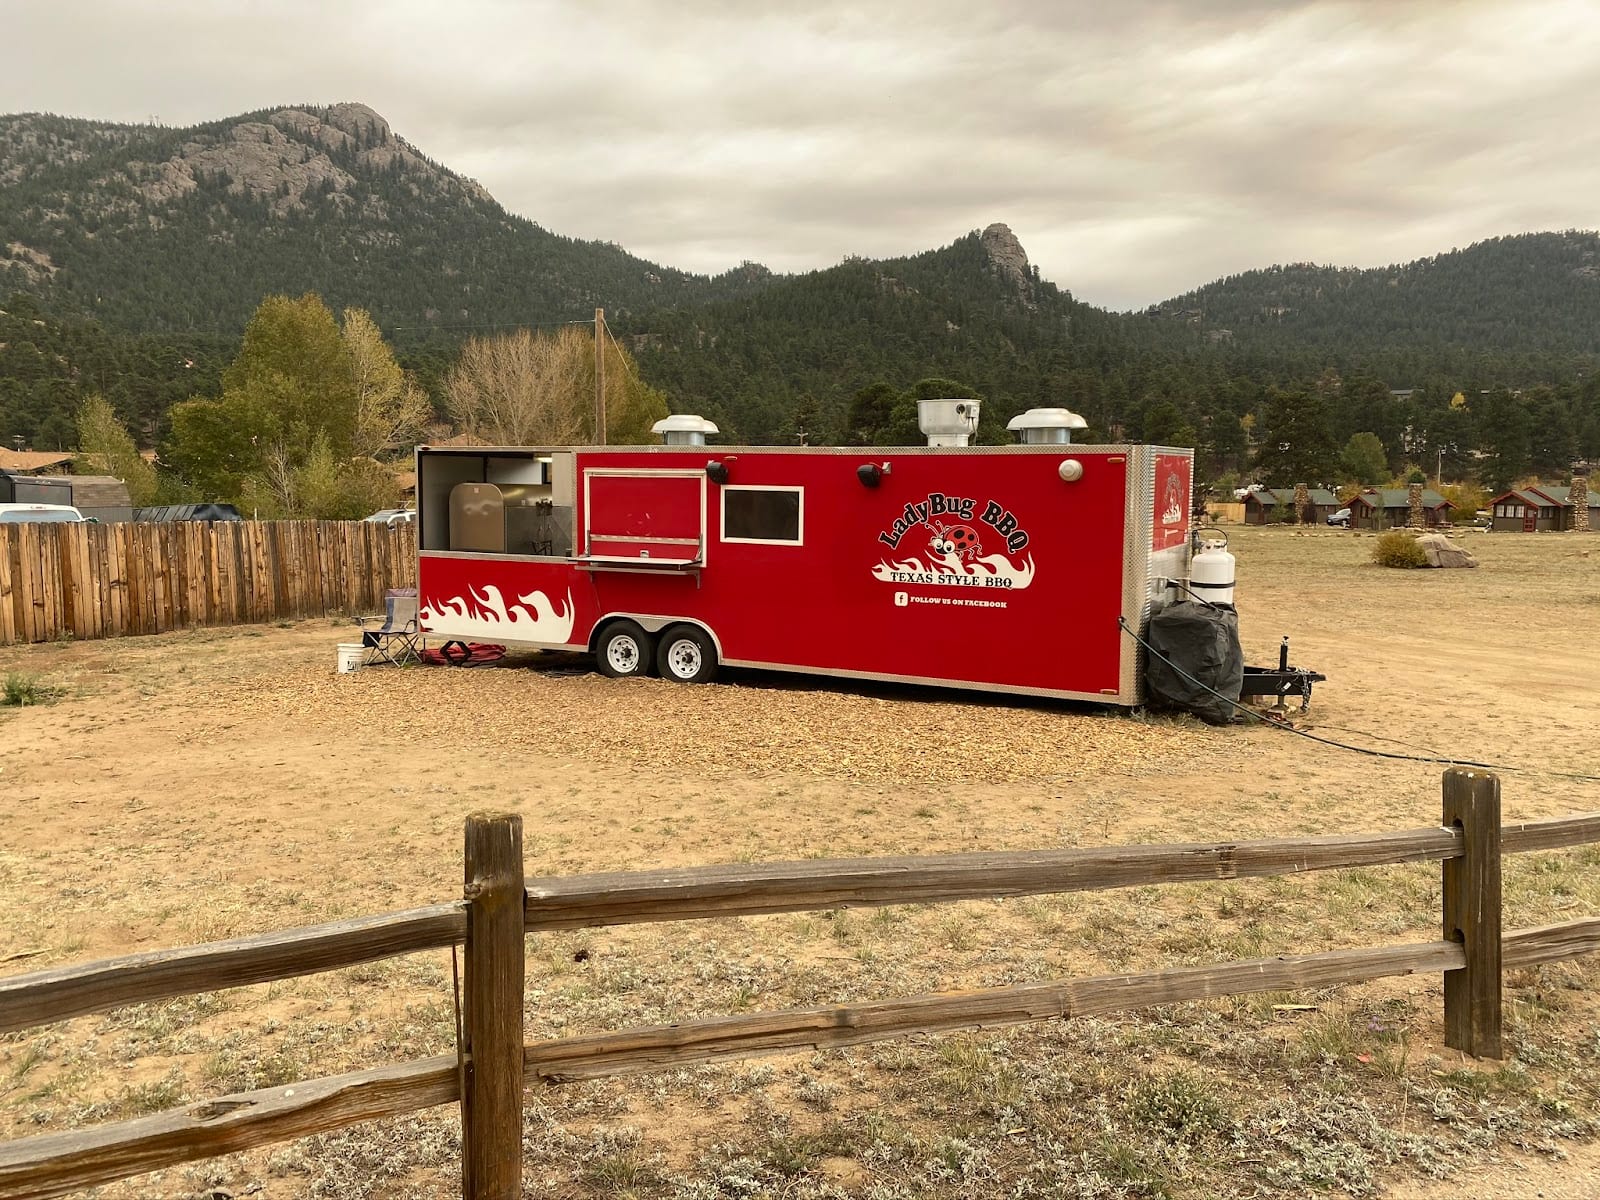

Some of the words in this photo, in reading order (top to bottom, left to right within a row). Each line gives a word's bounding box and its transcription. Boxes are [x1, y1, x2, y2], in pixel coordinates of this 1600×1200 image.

[878, 493, 977, 550] LadyBug
[979, 500, 1029, 554] BBQ
[890, 572, 933, 583] TEXAS
[938, 574, 980, 586] STYLE
[985, 577, 1013, 589] BBQ
[910, 596, 941, 604] FOLLOW
[964, 600, 1007, 608] FACEBOOK
